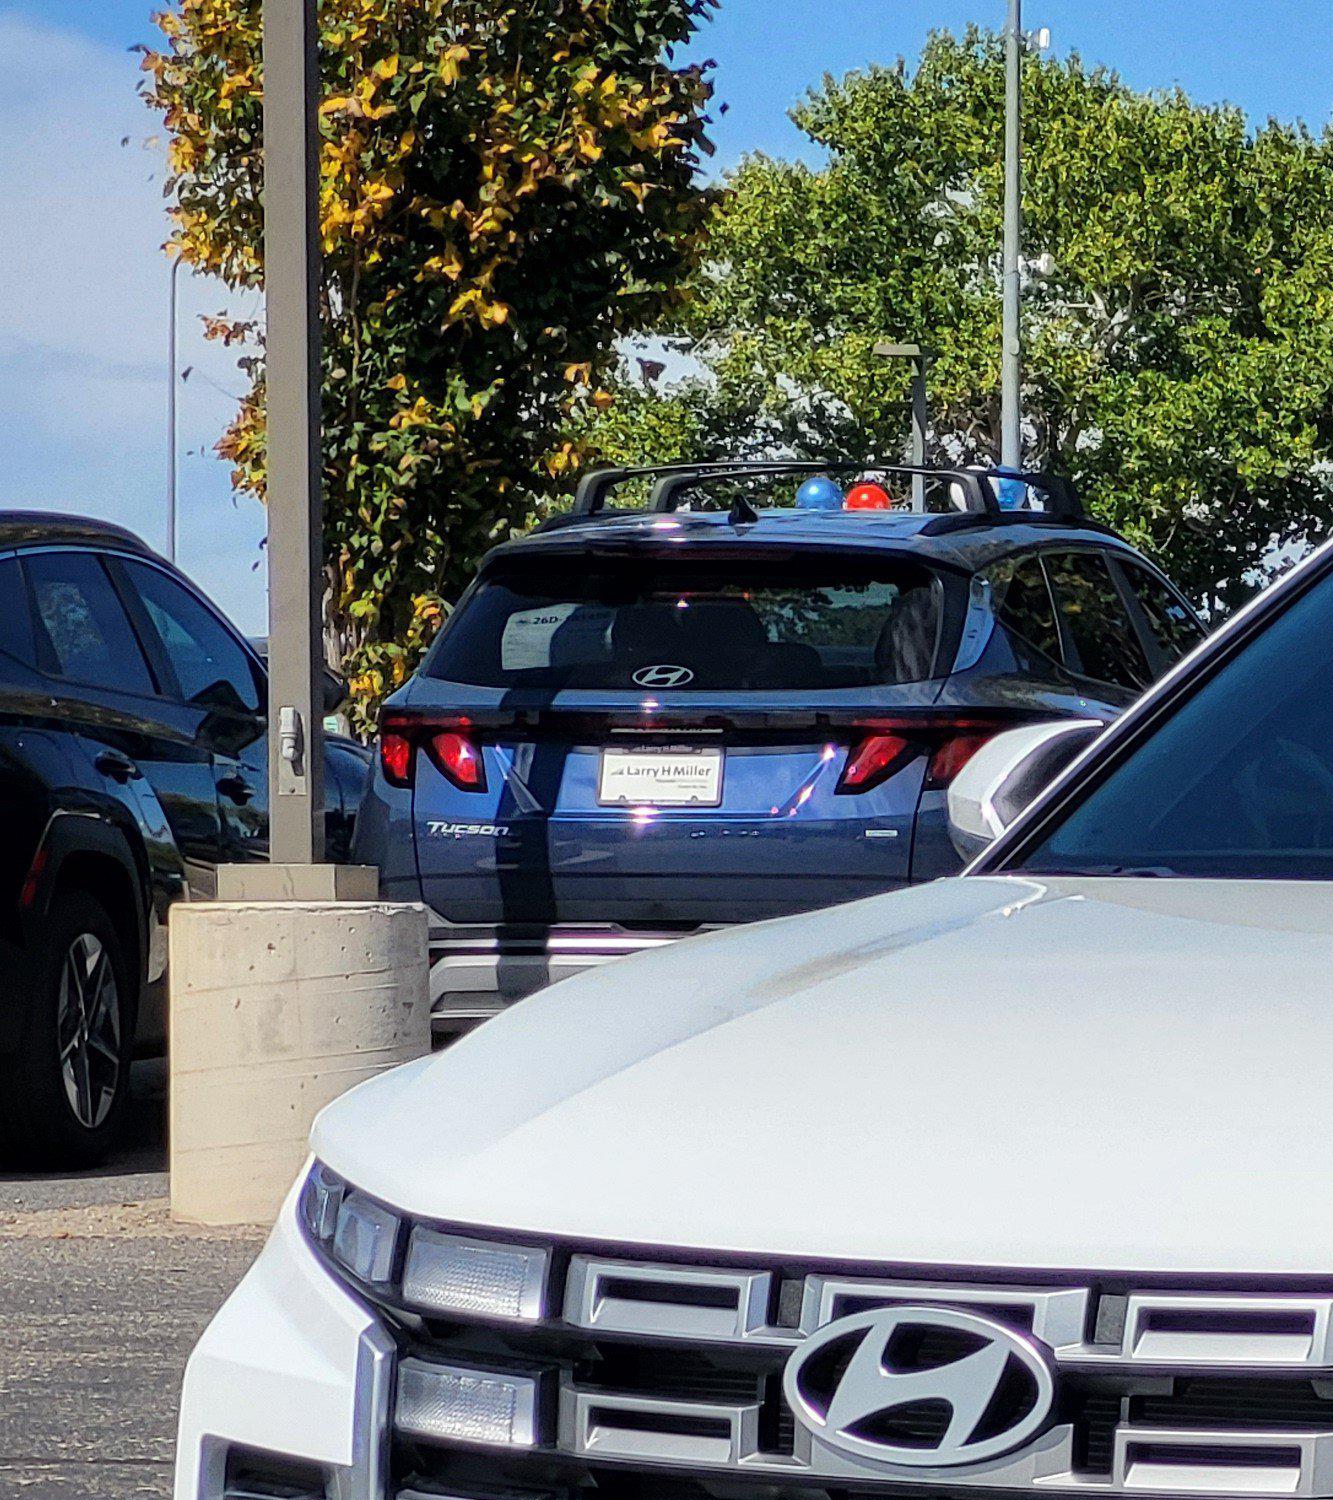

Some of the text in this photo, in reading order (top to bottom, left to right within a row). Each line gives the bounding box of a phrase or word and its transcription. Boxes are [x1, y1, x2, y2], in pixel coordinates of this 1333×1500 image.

[627, 765, 711, 778] Larry H Miller
